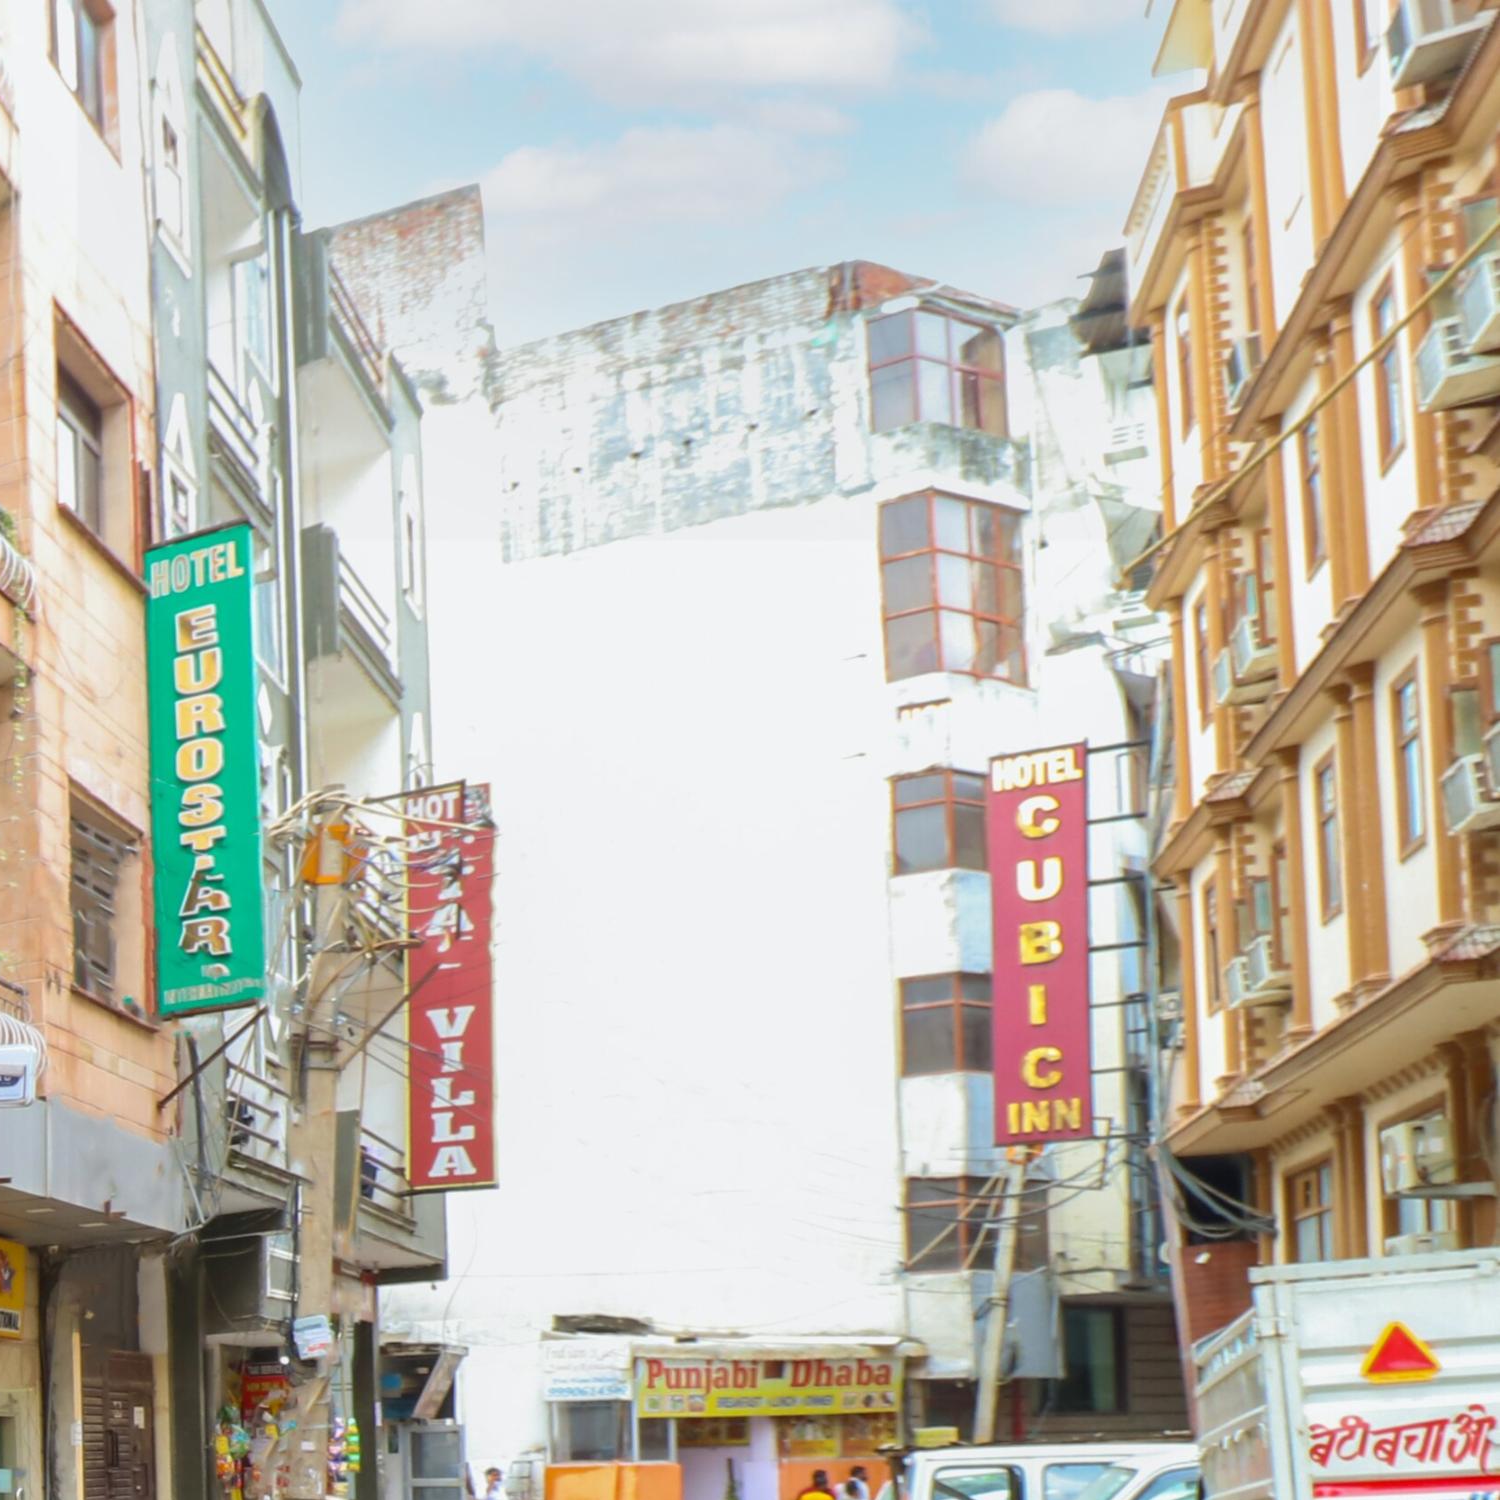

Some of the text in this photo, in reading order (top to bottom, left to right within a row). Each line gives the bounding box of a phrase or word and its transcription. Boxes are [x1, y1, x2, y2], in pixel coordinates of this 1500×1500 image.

[150, 541, 244, 598] HOTEL
[173, 604, 232, 956] EUROSTAR
[992, 749, 1083, 792] HOTEL
[1016, 795, 1064, 1090] CUBIC
[425, 1005, 477, 1178] VILLA
[1007, 1098, 1082, 1135] INN
[647, 1358, 893, 1394] Punjabi Dhaba
[1309, 1415, 1370, 1468] बेटी
